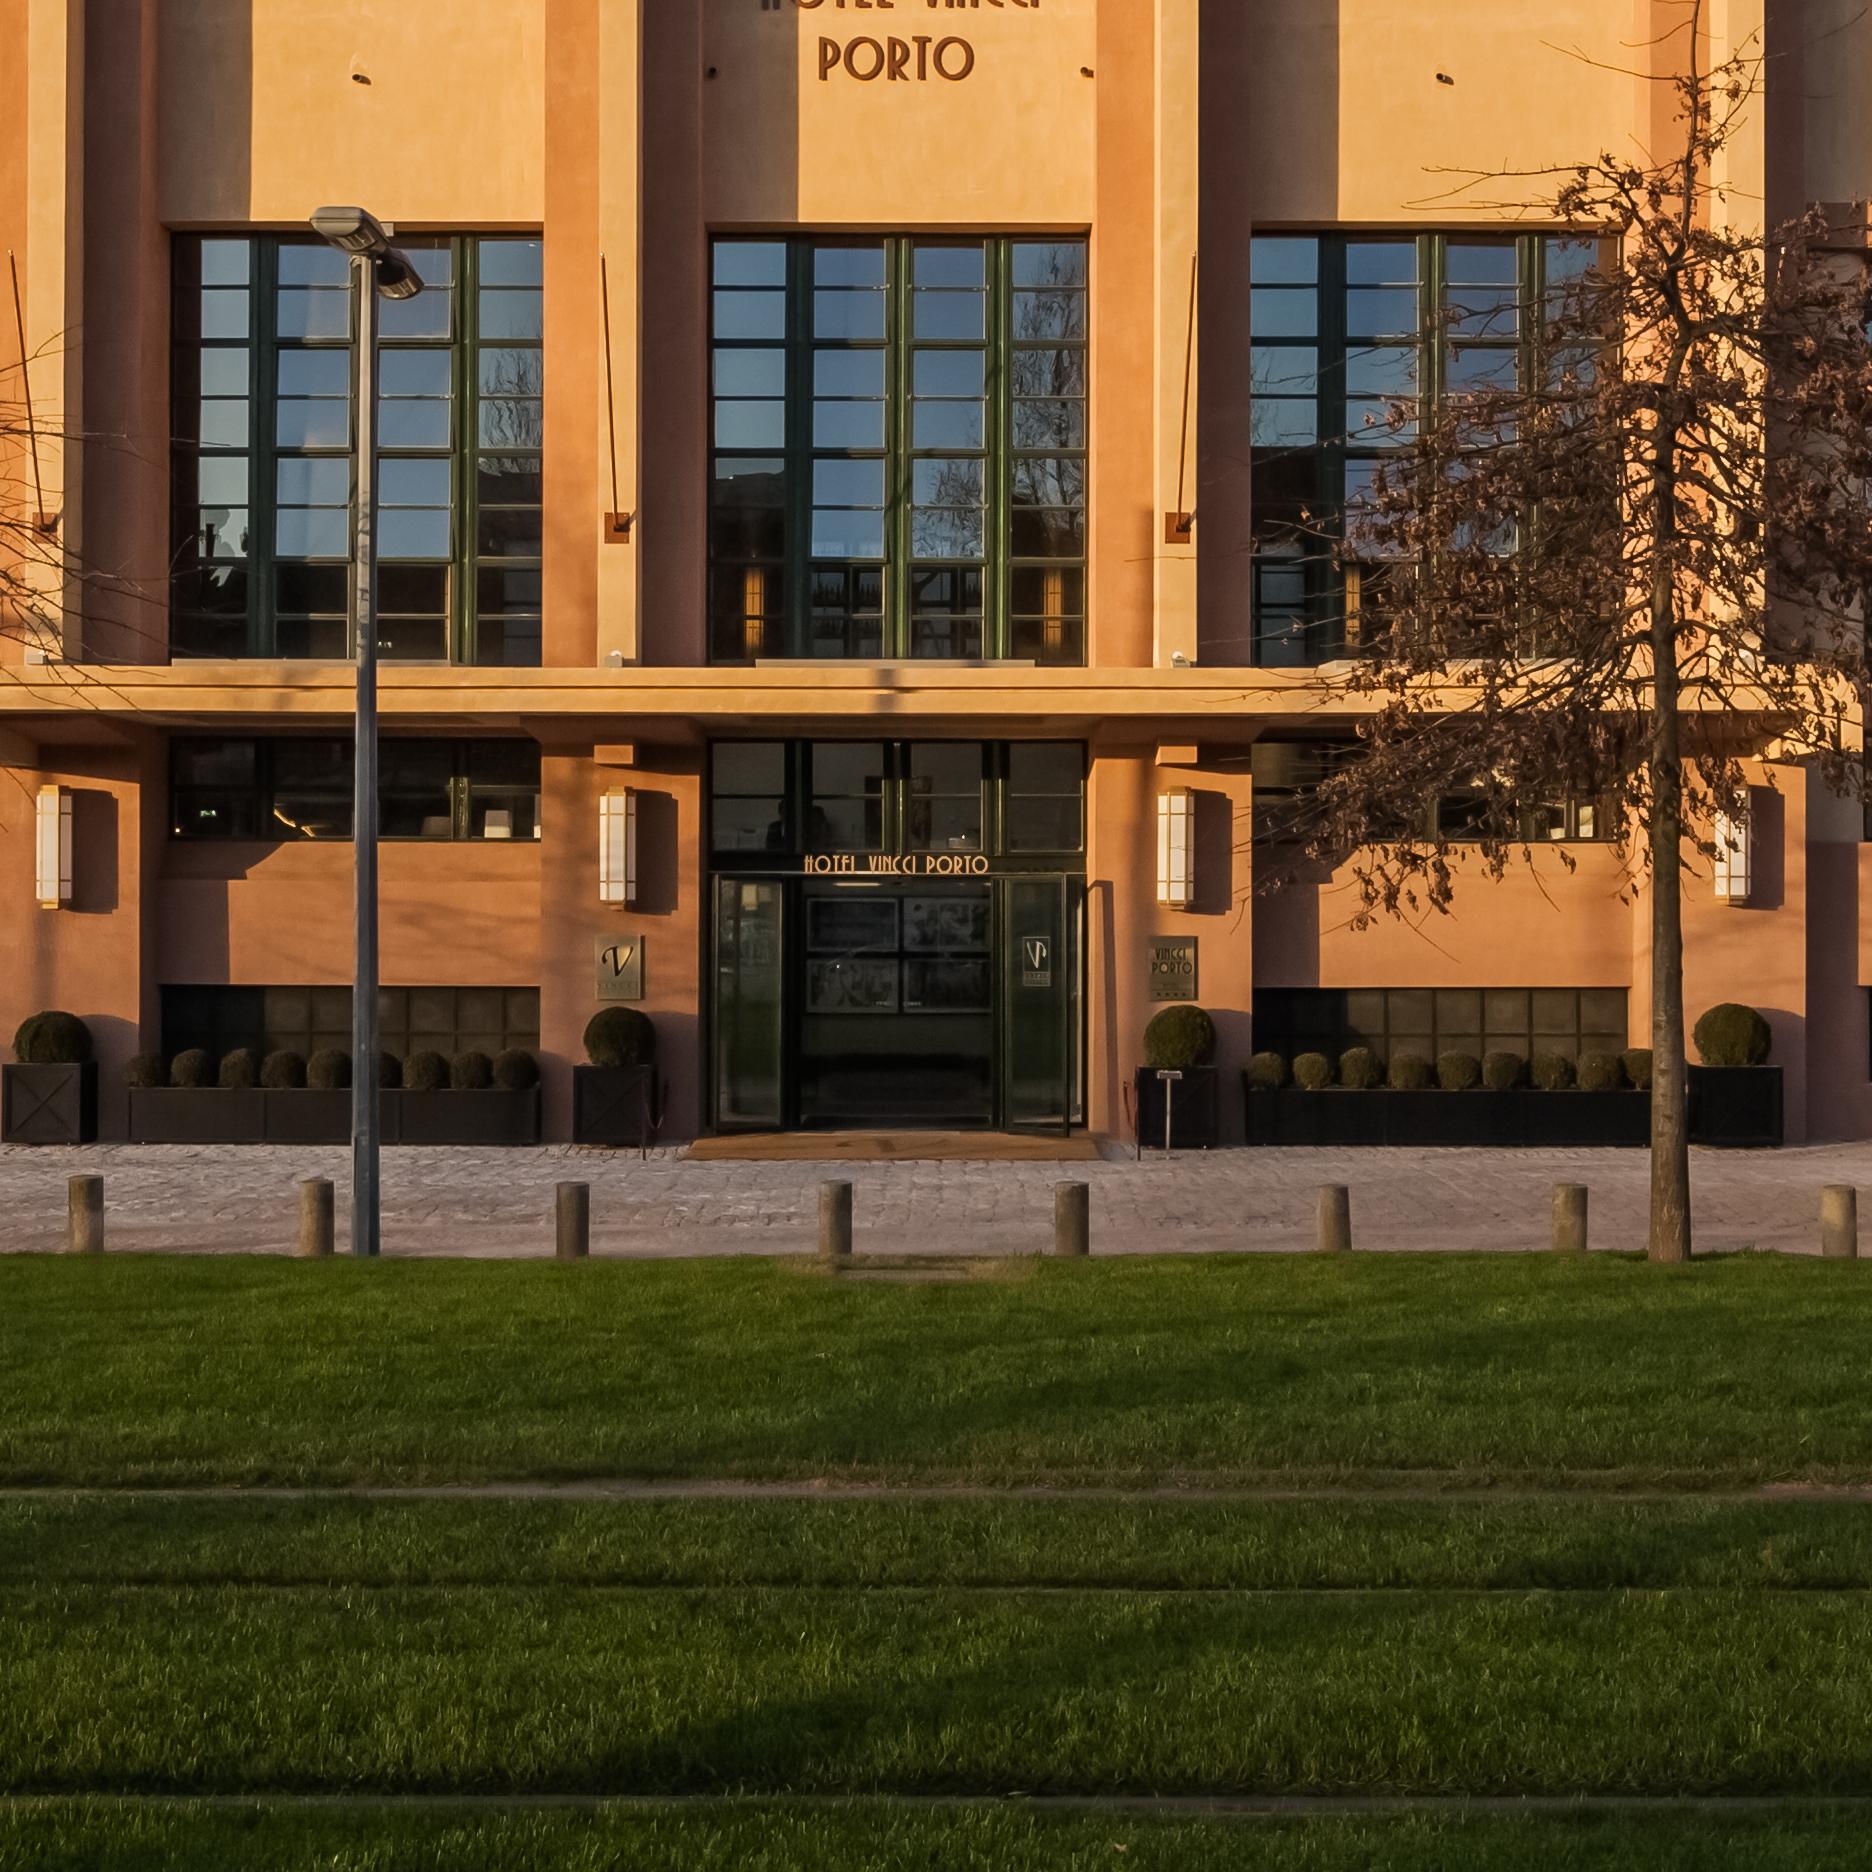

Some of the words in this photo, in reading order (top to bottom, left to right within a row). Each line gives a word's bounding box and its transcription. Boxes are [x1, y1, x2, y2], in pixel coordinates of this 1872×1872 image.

[818, 36, 975, 81] PORTO
[868, 855, 916, 874] VINCCI
[926, 855, 989, 874] PORTO
[1155, 947, 1186, 960] VINCCI
[1152, 961, 1192, 975] PORTO
